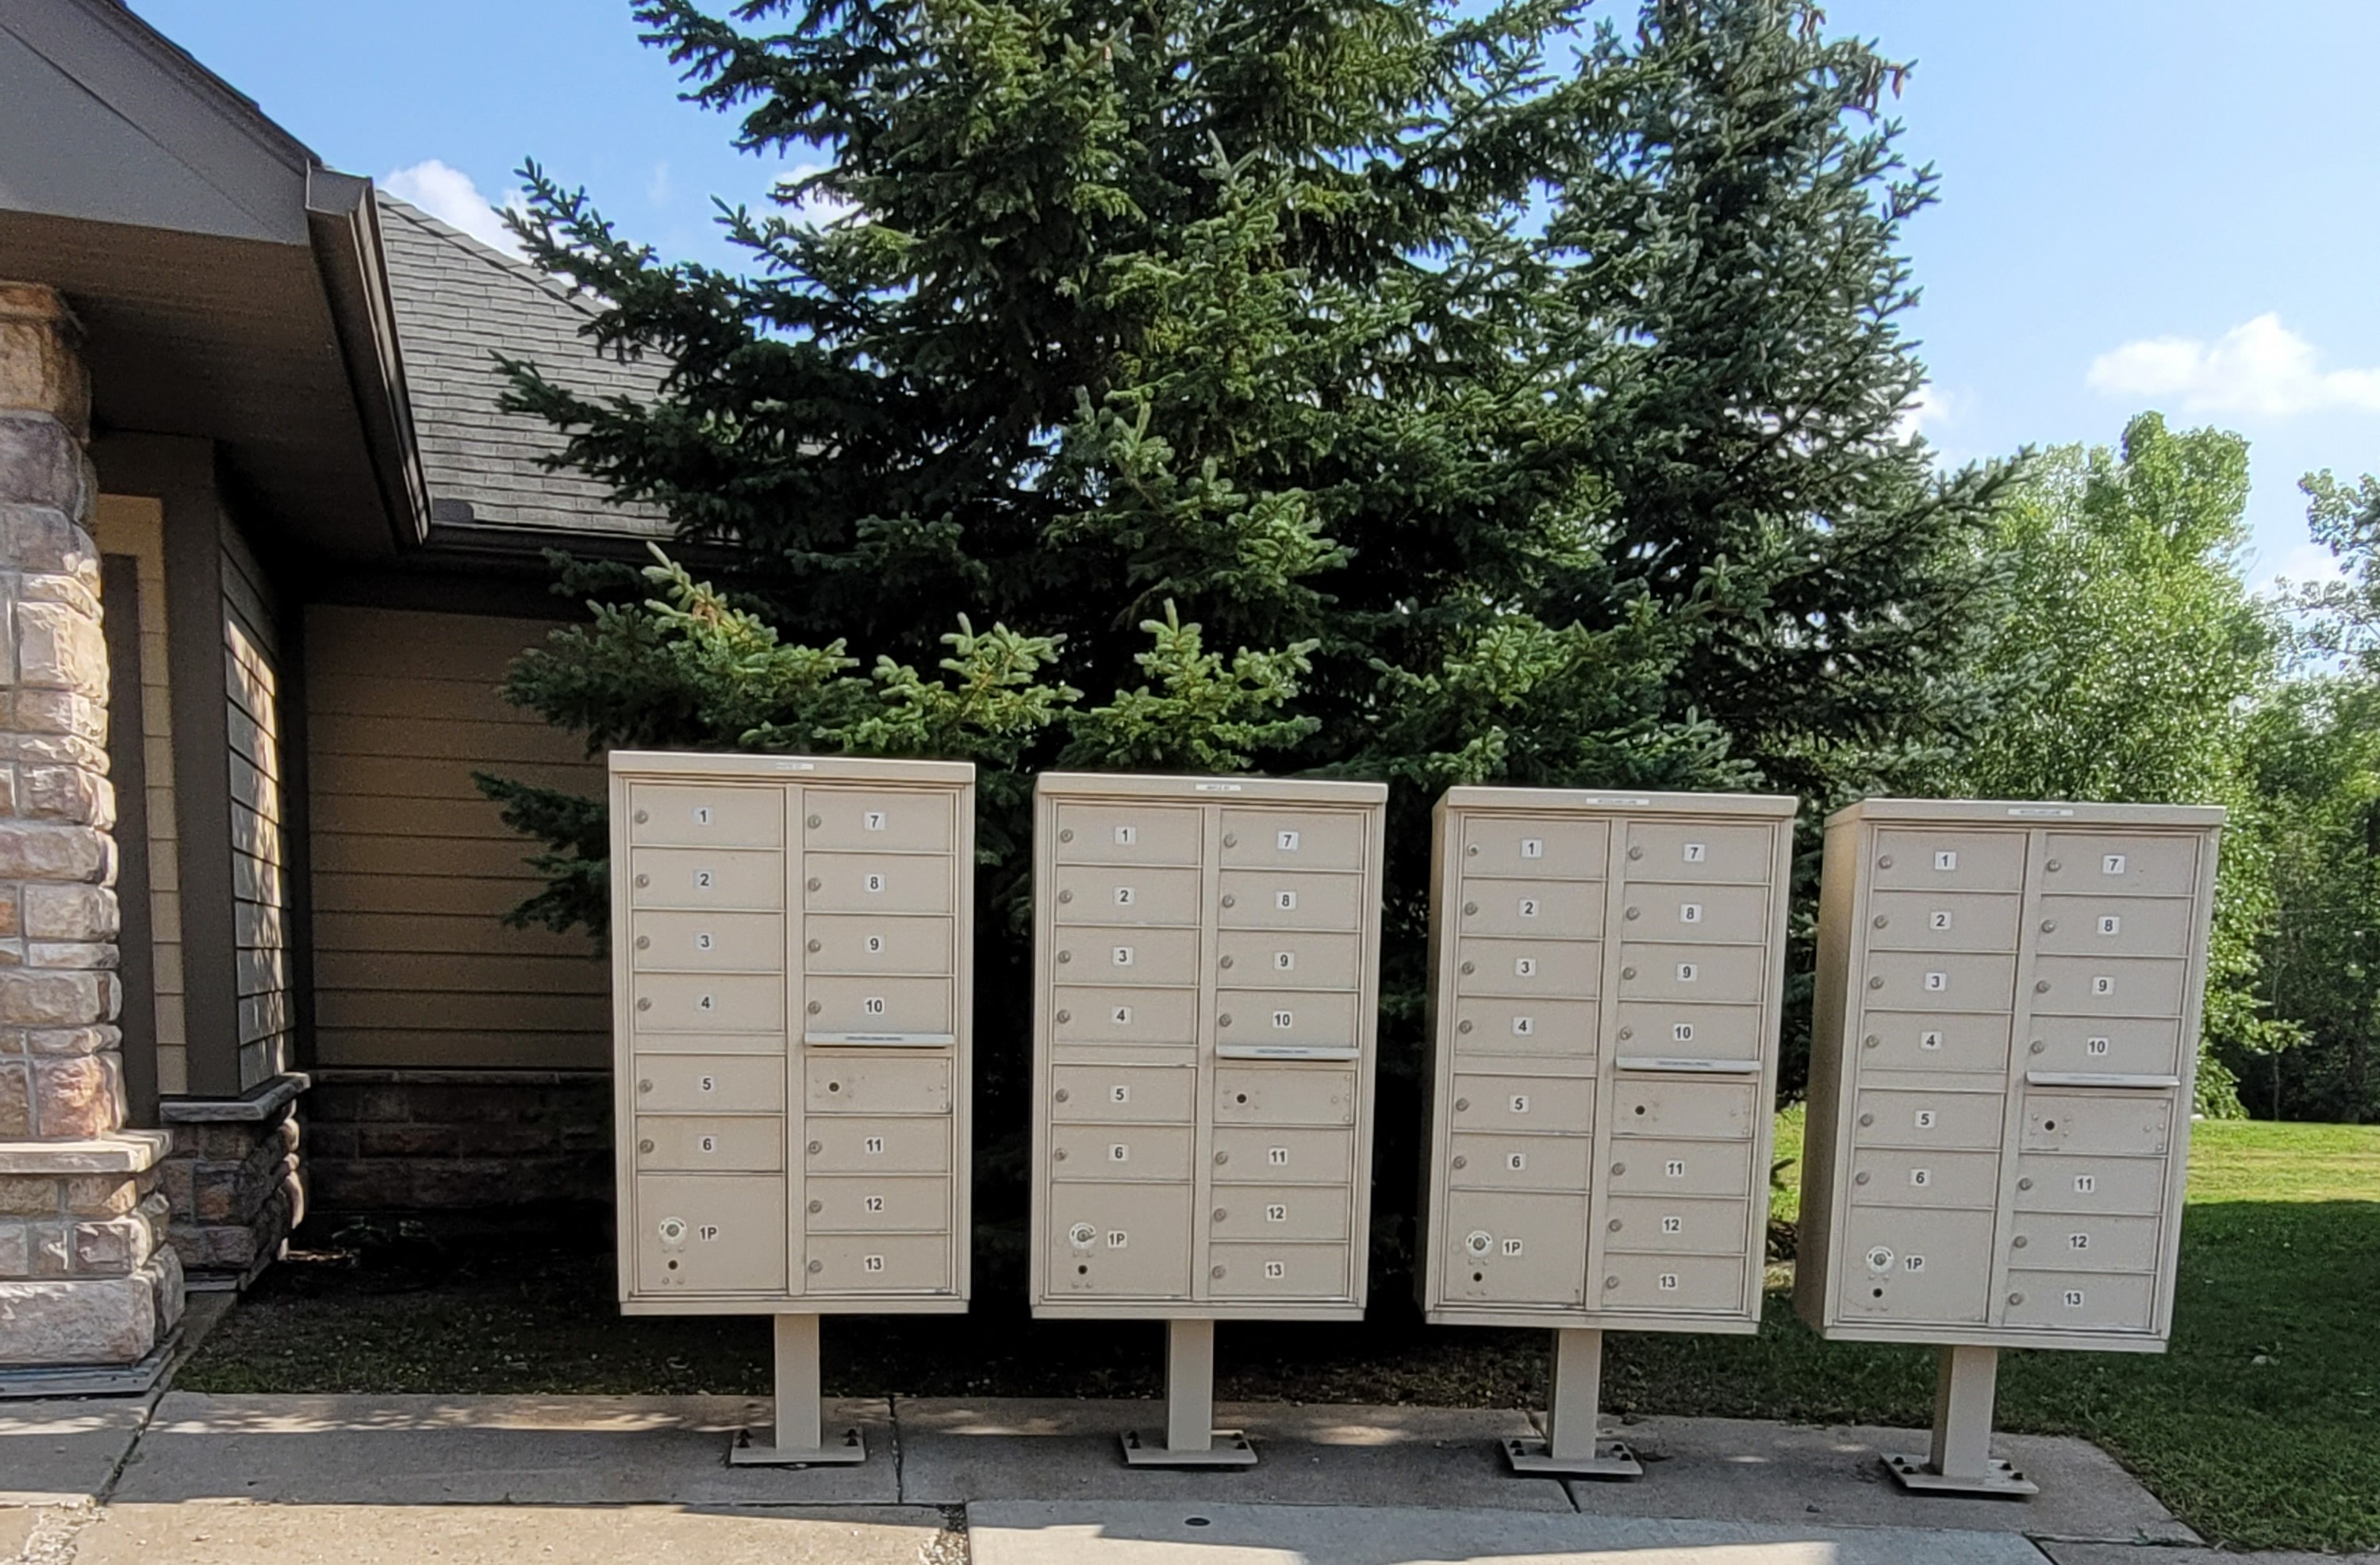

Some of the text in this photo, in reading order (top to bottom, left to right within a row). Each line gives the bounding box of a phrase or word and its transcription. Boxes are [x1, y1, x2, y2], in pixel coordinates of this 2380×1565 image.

[699, 810, 707, 823] 1
[870, 815, 879, 828] 7
[1121, 829, 1129, 842] 1
[1284, 834, 1292, 847] 7
[1527, 842, 1535, 854] 1
[1691, 846, 1699, 859] 7
[1940, 854, 1949, 867] 1
[2109, 858, 2119, 871] 7
[700, 873, 709, 886] 2
[869, 876, 879, 890] 8
[1120, 889, 1129, 903] 2
[1281, 894, 1290, 907] 8
[1525, 901, 1534, 915] 2
[1686, 907, 1695, 920] 8
[1936, 914, 1945, 927] 2
[2104, 919, 2113, 932] 8
[701, 934, 710, 948] 3
[869, 938, 879, 951] 9
[1119, 949, 1127, 962] 3
[1280, 954, 1288, 967] 9
[1521, 961, 1530, 974] 3
[1683, 965, 1691, 979] 9
[1931, 976, 1940, 988] 3
[2098, 980, 2107, 992] 9
[701, 996, 710, 1009] 4
[866, 999, 882, 1013] 10
[1116, 1009, 1125, 1021] 4
[1274, 1014, 1291, 1026] 10
[1518, 1020, 1527, 1032] 4
[1675, 1026, 1691, 1039] 10
[1926, 1034, 1936, 1046] 4
[2088, 1040, 2106, 1053] 10
[703, 1077, 712, 1091] 5
[1115, 1088, 1124, 1101] 5
[1514, 1097, 1523, 1110] 5
[1921, 1113, 1929, 1126] 5
[703, 1137, 712, 1151] 6
[866, 1139, 881, 1152] 11
[1115, 1146, 1123, 1159] 6
[1270, 1150, 1285, 1163] 11
[1511, 1155, 1521, 1168] 6
[1668, 1163, 1683, 1175] 11
[1915, 1172, 1925, 1184] 6
[2077, 1178, 2092, 1191] 11
[866, 1198, 882, 1210] 12
[1268, 1206, 1284, 1219] 12
[1664, 1218, 1679, 1231] 12
[699, 1226, 717, 1240] 1P
[1108, 1233, 1125, 1245] 1P
[1503, 1241, 1521, 1253] 1P
[2070, 1236, 2087, 1249] 12
[865, 1257, 882, 1270] 13
[1266, 1264, 1282, 1276] 13
[1906, 1257, 1923, 1270] 1P
[1660, 1275, 1676, 1288] 13
[2065, 1292, 2081, 1305] 13
